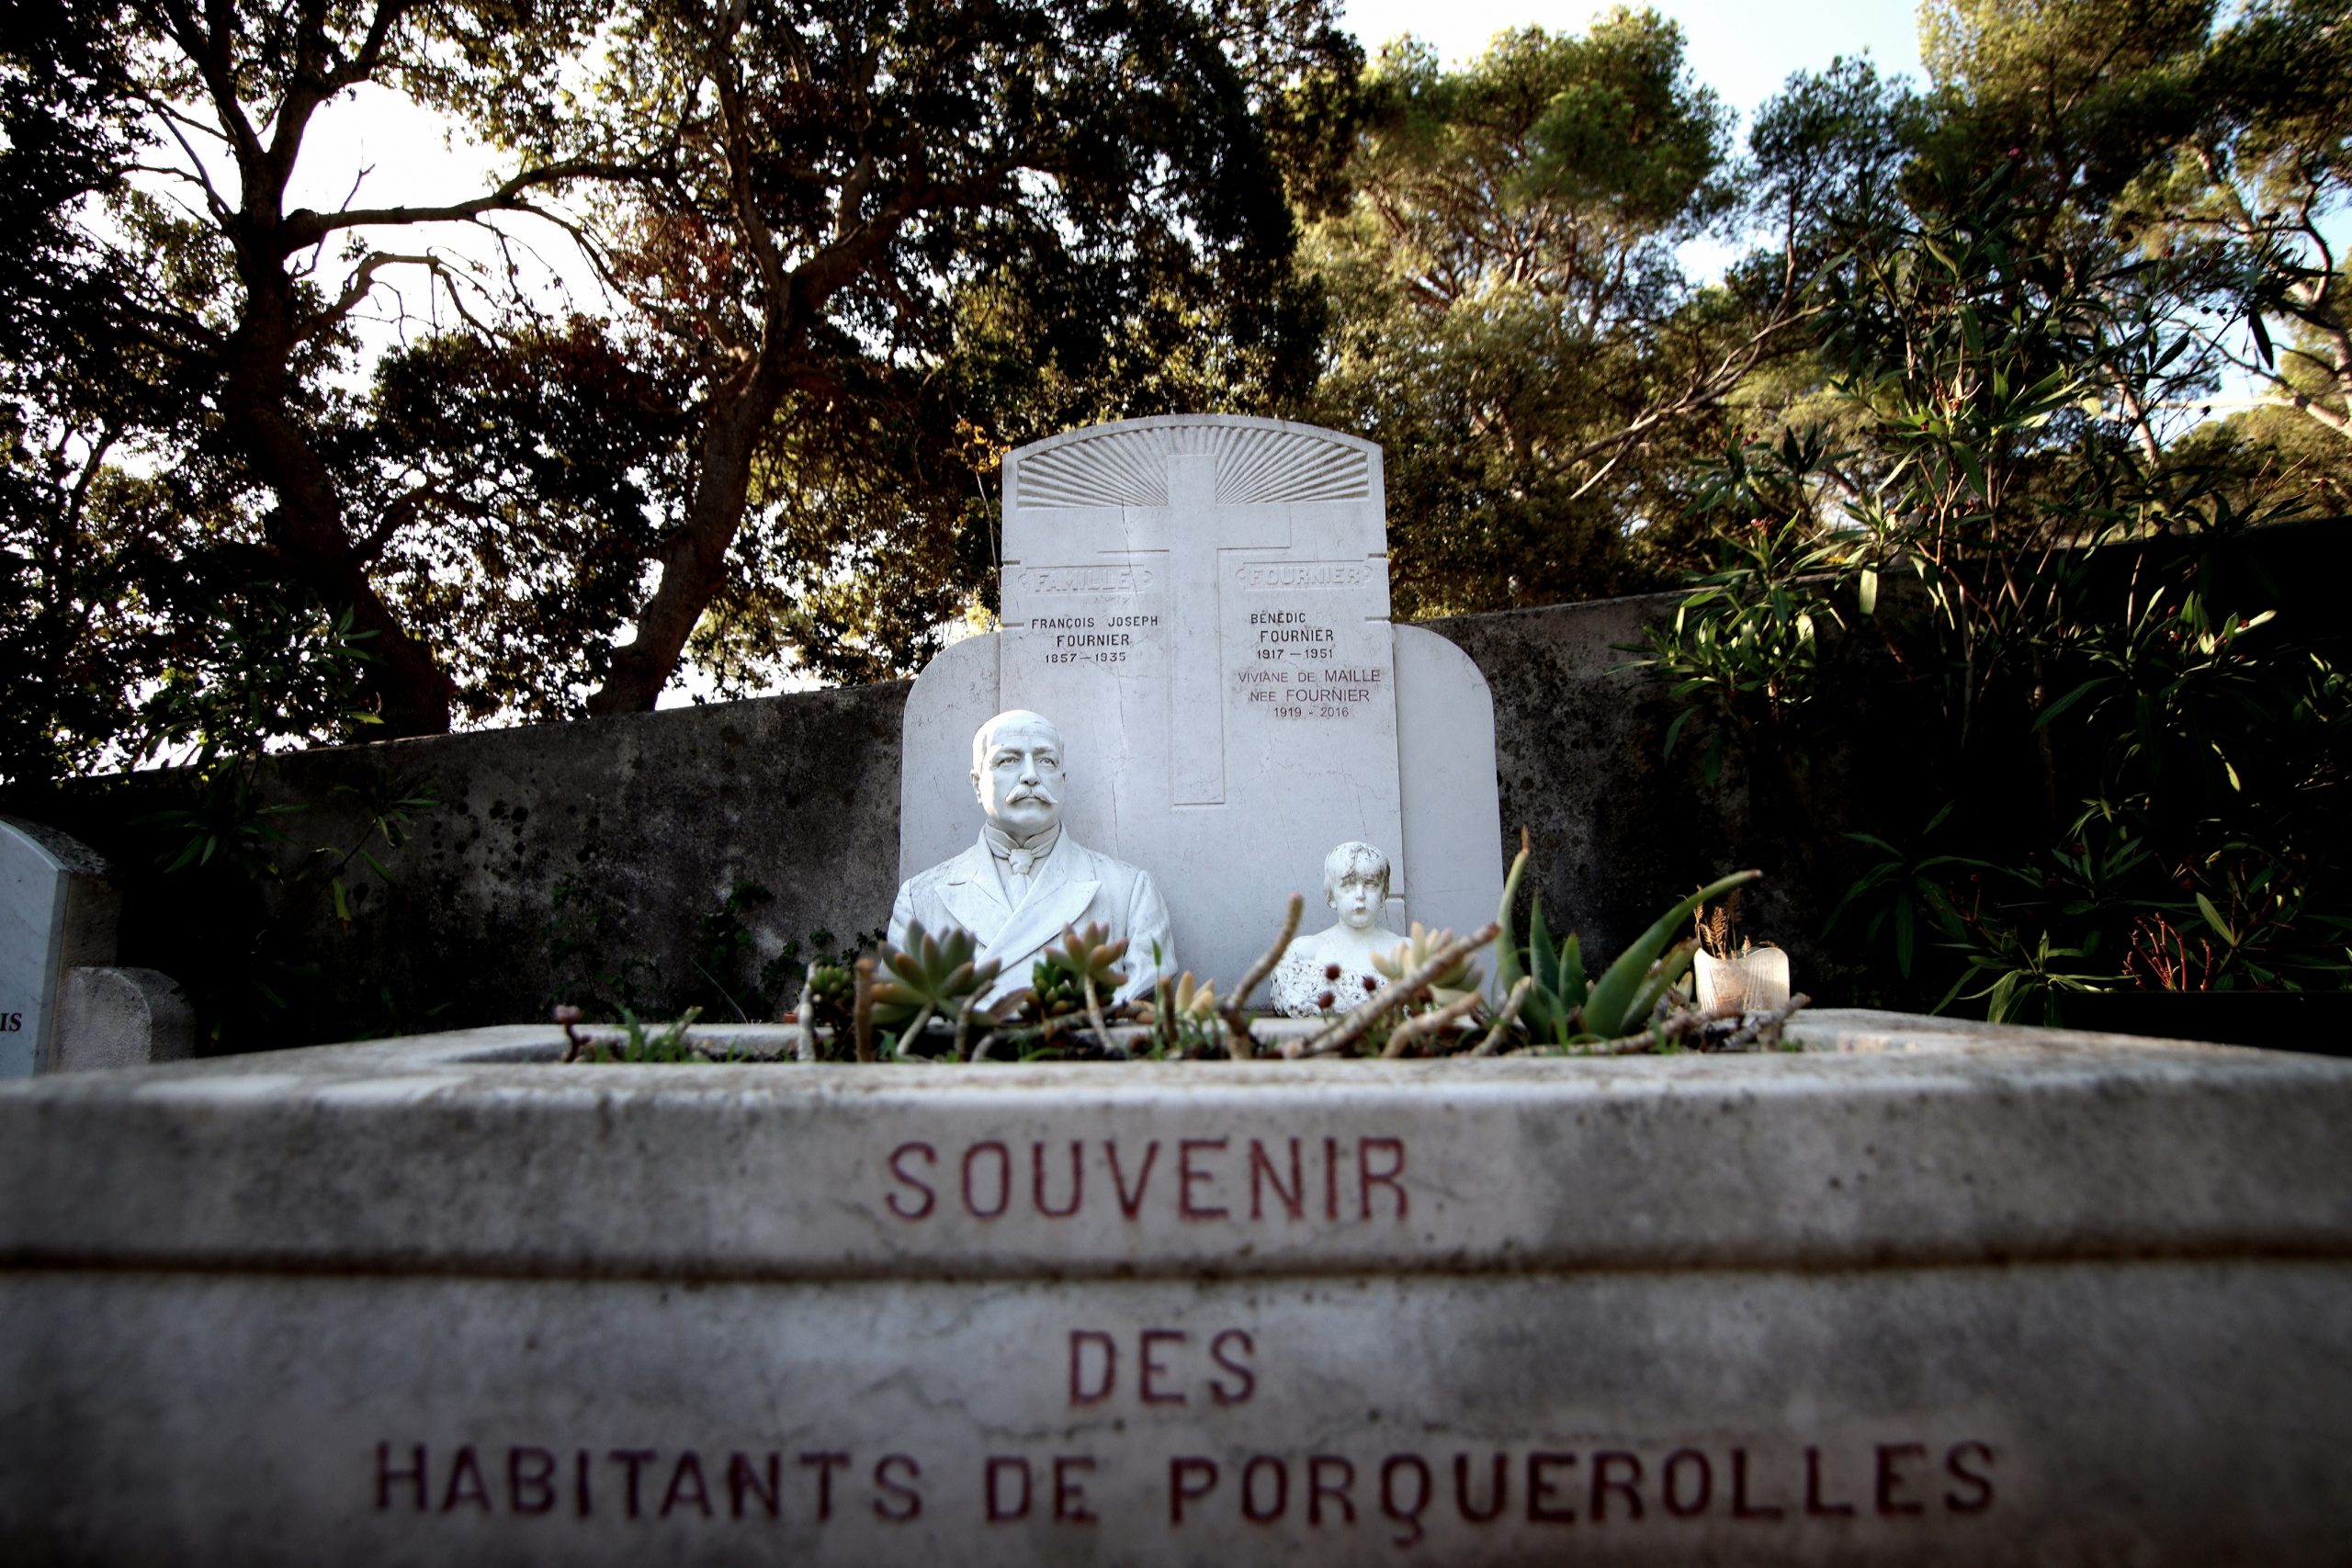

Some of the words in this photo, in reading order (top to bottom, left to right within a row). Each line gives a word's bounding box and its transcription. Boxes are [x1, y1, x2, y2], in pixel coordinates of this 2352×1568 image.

[1034, 569, 1133, 592] FAMILLE
[1249, 565, 1361, 586] FOURNIER
[1031, 616, 1095, 630] FRANÇOIS
[1107, 615, 1159, 627] JOSEPH
[1057, 633, 1130, 648] FOURNIER
[1260, 629, 1334, 643] FOURNIER
[1238, 671, 1289, 683] VIVIANE
[1297, 672, 1317, 683] DE
[1325, 670, 1382, 683] MAILLE
[1250, 691, 1277, 703] NEE
[1286, 689, 1370, 703] FOURNIER
[1274, 706, 1303, 718] 1919
[1320, 706, 1350, 718] 2016
[888, 1137, 1408, 1221] SOUVENIR
[1069, 1329, 1257, 1407] DES
[375, 1442, 923, 1524] HABITANTS
[985, 1454, 1097, 1525] DE
[1170, 1440, 1996, 1549] PORQUEROLLES
